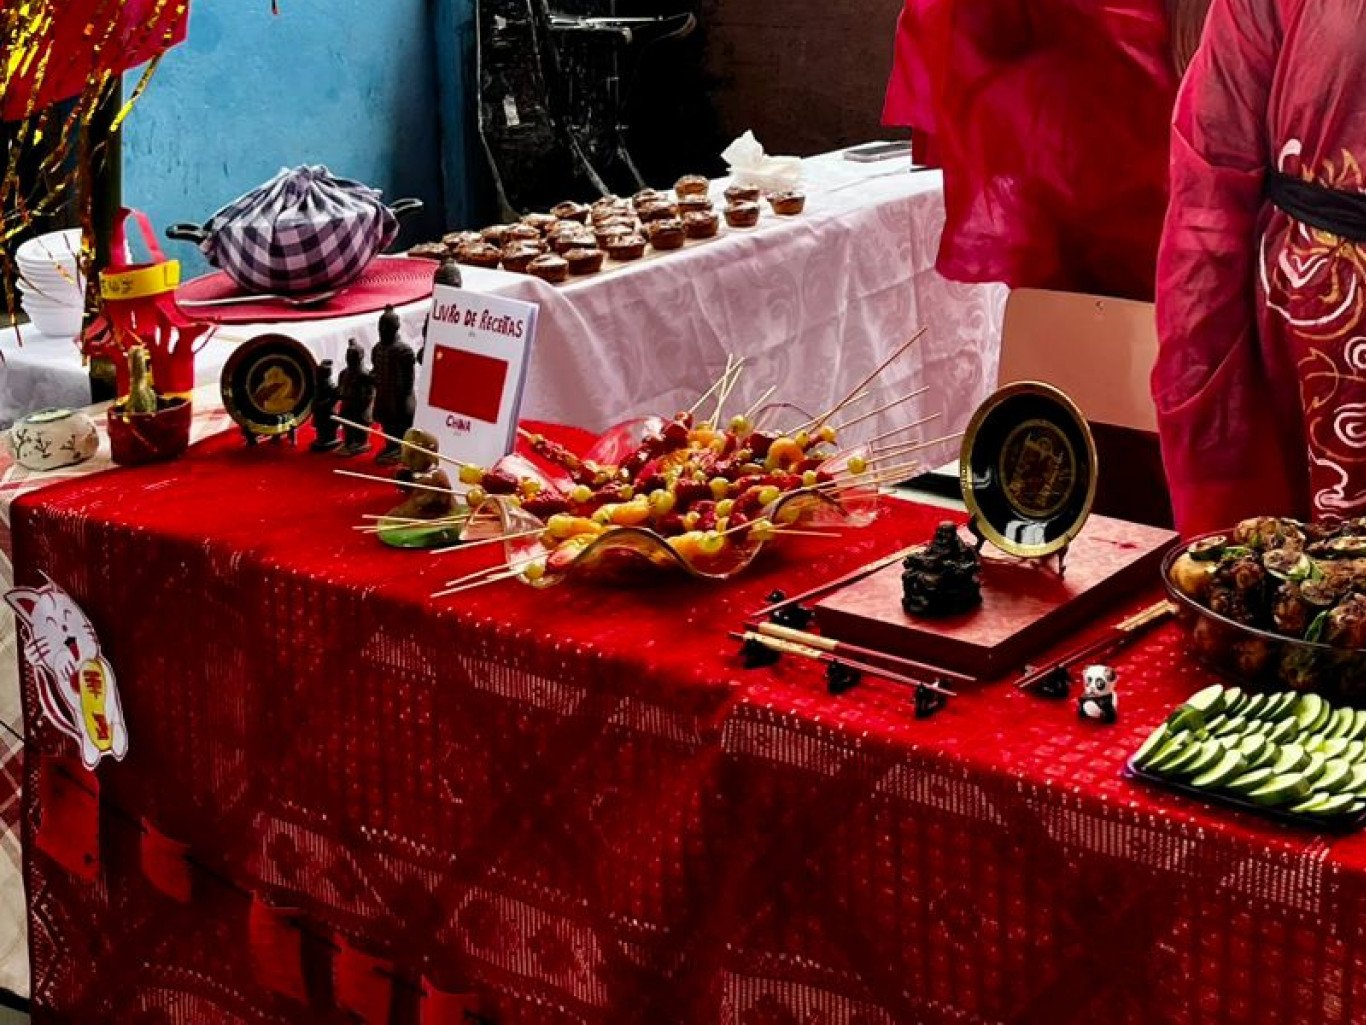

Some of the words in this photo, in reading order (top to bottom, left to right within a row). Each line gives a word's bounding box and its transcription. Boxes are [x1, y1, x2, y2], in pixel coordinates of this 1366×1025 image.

[432, 299, 461, 324] LIVRO
[464, 308, 477, 327] DE
[479, 309, 524, 338] RECEITAS
